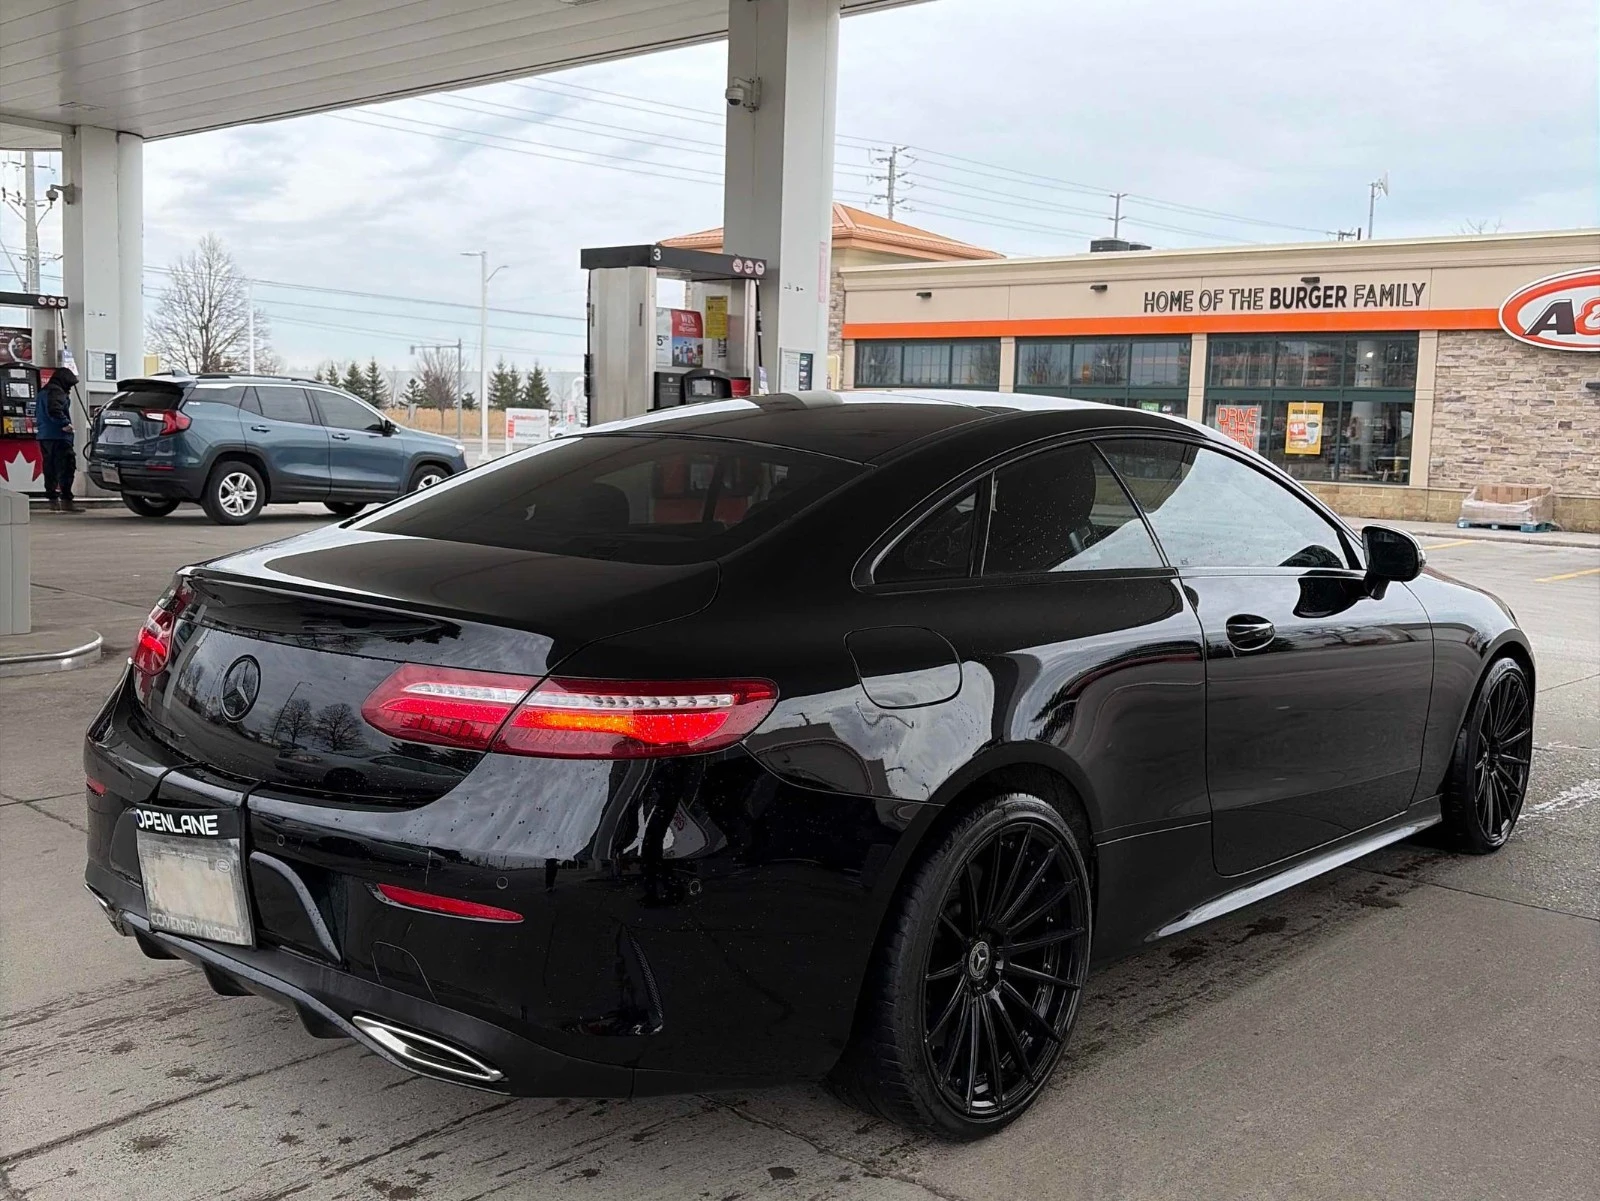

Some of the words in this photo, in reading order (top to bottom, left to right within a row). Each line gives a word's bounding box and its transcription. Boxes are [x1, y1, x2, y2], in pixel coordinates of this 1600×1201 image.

[653, 247, 662, 261] 3
[1144, 290, 1194, 313] HOME
[1198, 289, 1224, 311] OF
[1229, 287, 1264, 311] THE
[1269, 285, 1347, 309] BURGER
[1353, 282, 1426, 308] FAMILY
[1218, 407, 1258, 423] DRIVE
[1217, 421, 1256, 437] THRU
[136, 809, 219, 835] OPENLANE
[151, 914, 204, 935] COVENTRY
[206, 925, 243, 942] NORTH
